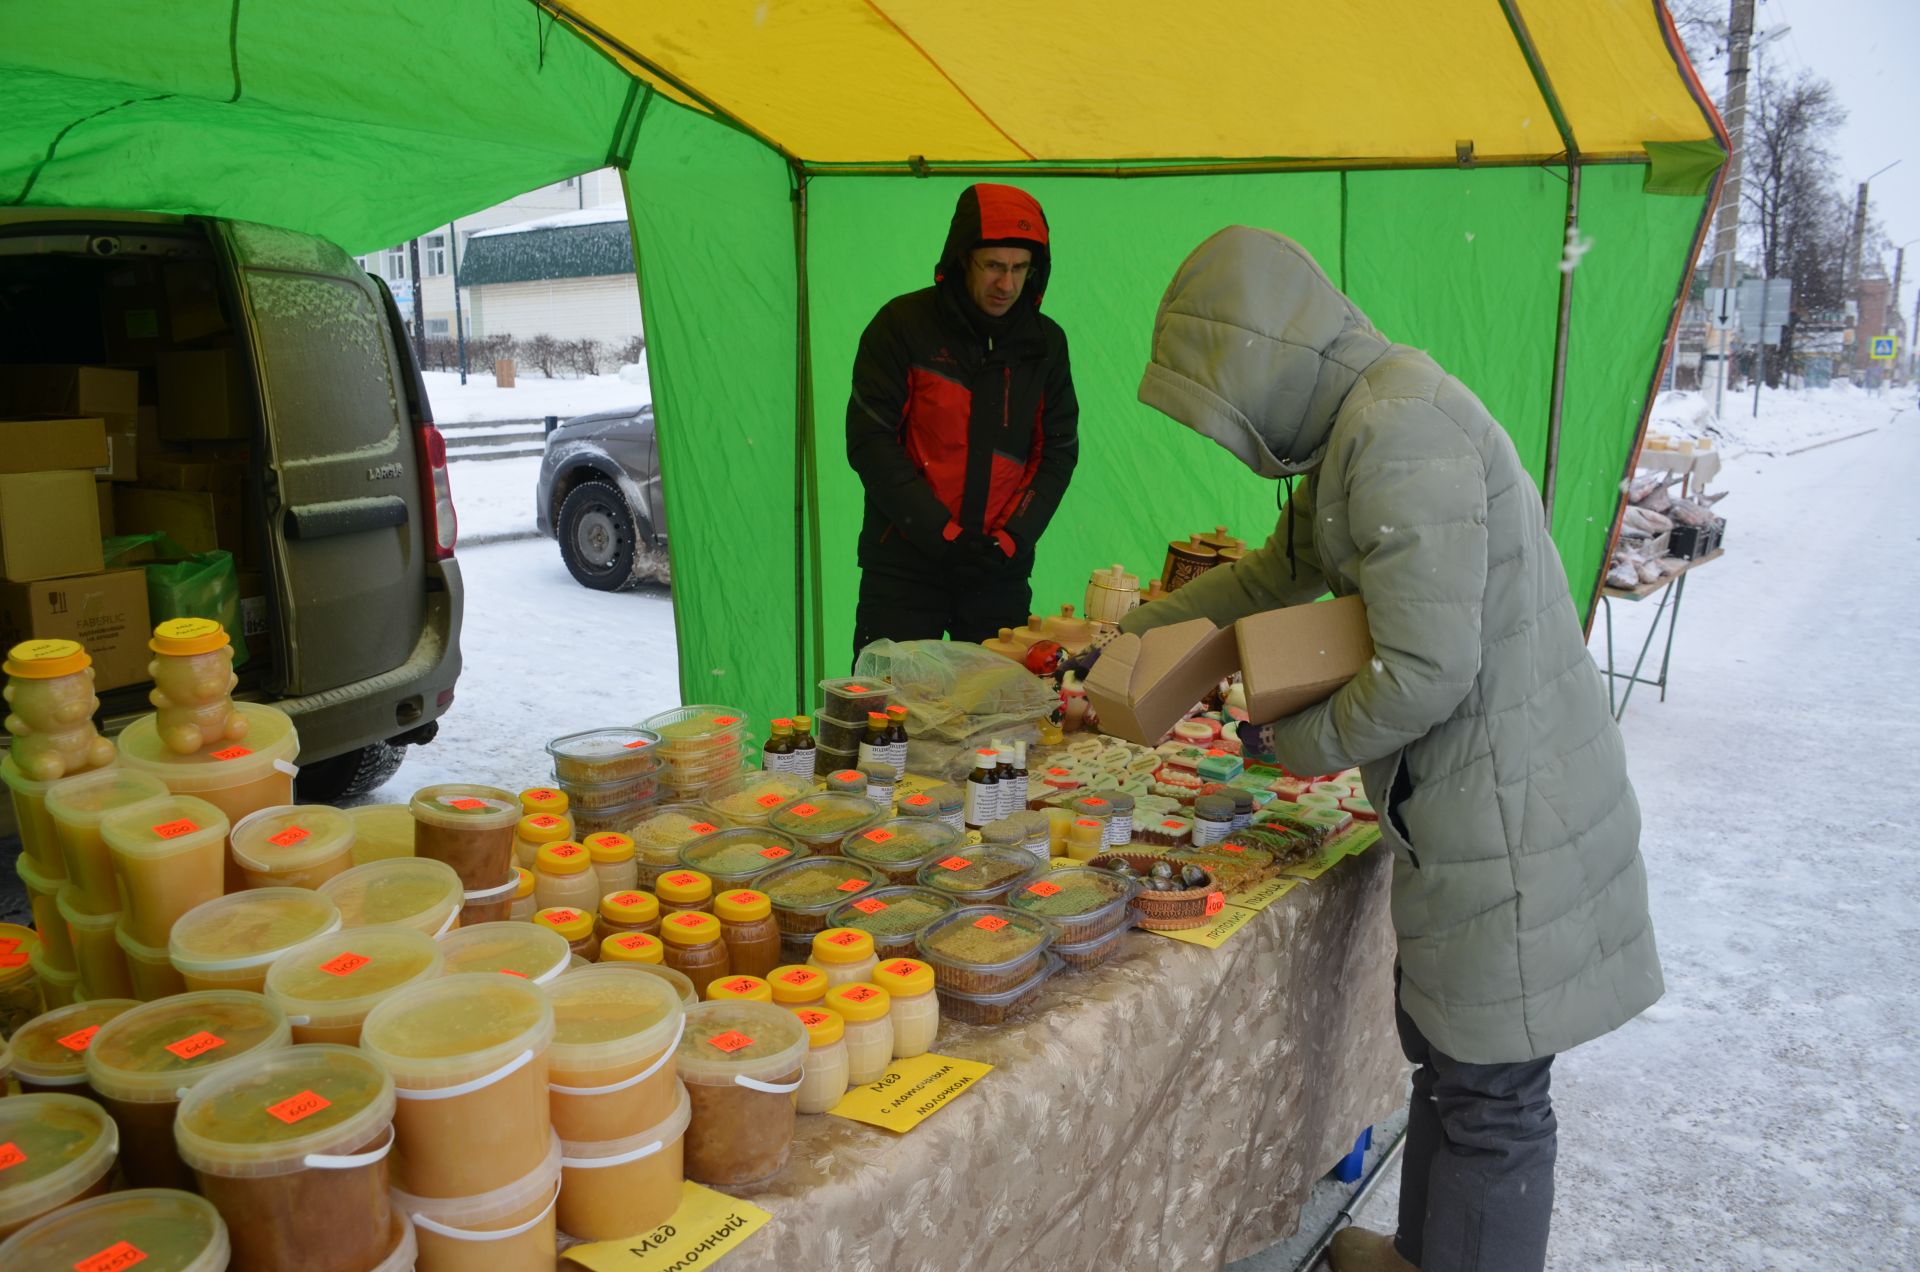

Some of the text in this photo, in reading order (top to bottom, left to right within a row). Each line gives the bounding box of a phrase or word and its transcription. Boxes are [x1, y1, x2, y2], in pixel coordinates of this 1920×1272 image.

[76, 612, 125, 629] FABERLIC
[1244, 884, 1286, 905] ПЫЛЬЦА
[1208, 901, 1222, 911] 100
[1206, 911, 1246, 940] ПРОПОЛИС
[870, 1073, 901, 1093] Мёд
[891, 1065, 954, 1108] маточным
[916, 1076, 974, 1116] молочком
[289, 1099, 318, 1116] 600
[629, 1224, 677, 1258] Мёд
